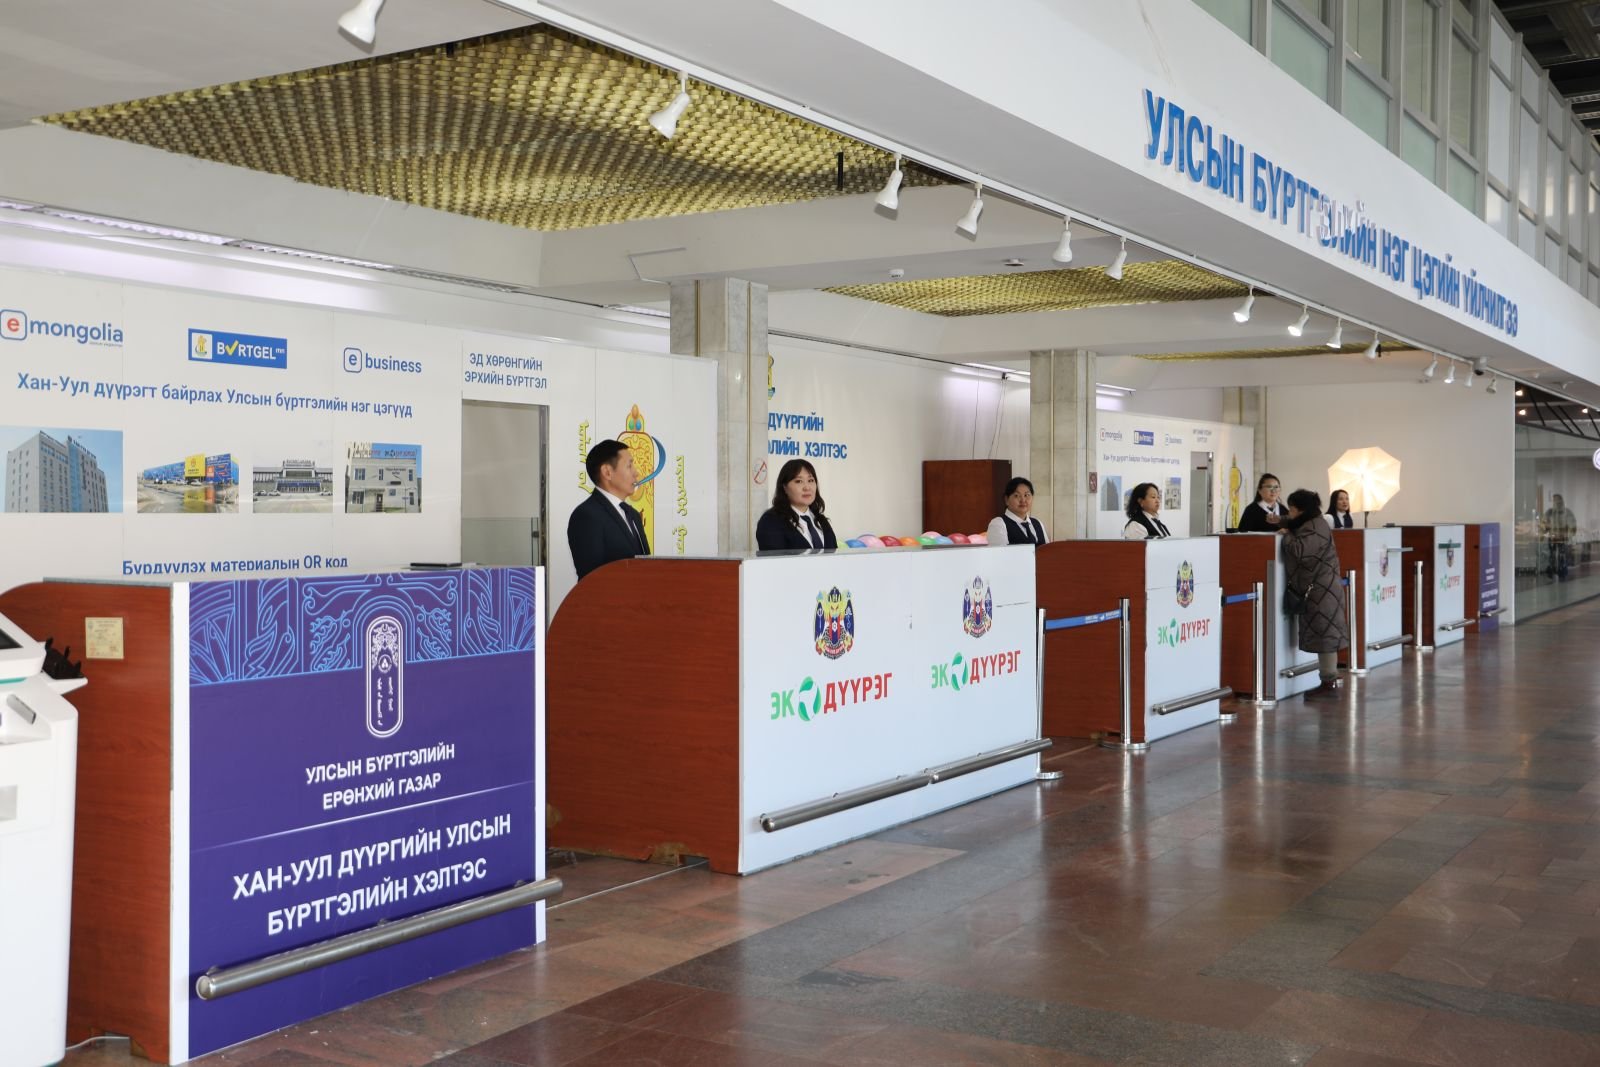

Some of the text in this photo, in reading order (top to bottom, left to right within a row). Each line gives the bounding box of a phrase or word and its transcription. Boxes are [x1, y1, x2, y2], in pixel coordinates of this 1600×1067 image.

[1143, 88, 1245, 203] УЛСЫН
[1379, 228, 1410, 283] НЭГ
[1411, 254, 1461, 309] ЦЭГИЙН
[7, 318, 123, 344] e mongolia
[348, 353, 422, 373] e business
[469, 353, 543, 371] ЭД ХӨРӨНГИЙН
[464, 371, 547, 389] ЭРХИЙН БҮРТГЭЛ
[18, 373, 413, 418] Хан-Уул дүүрэгт байрлах Улсын бүртгэлийн нэг цэгүүд
[768, 412, 824, 432] ДҮҮРГИЙН
[805, 442, 848, 460] ХЭЛТЭС
[210, 558, 300, 573] материалын
[325, 557, 348, 568] код
[1180, 618, 1211, 644] ДҮҮРЭГ
[970, 650, 1021, 685] ДҮҮРЭГ
[823, 672, 893, 714] ДҮҮРЭГ
[306, 742, 456, 785] УЛСЫН БҮРТГЭЛИЙН
[323, 772, 442, 810] ЕРӨНХИЙ ГАЗАР
[232, 813, 512, 900] ХАН-УУЛ ДҮҮРГИЙН УЛСЫН
[267, 857, 488, 936] БҮРТГЭЛИЙН ХЭЛТЭС
